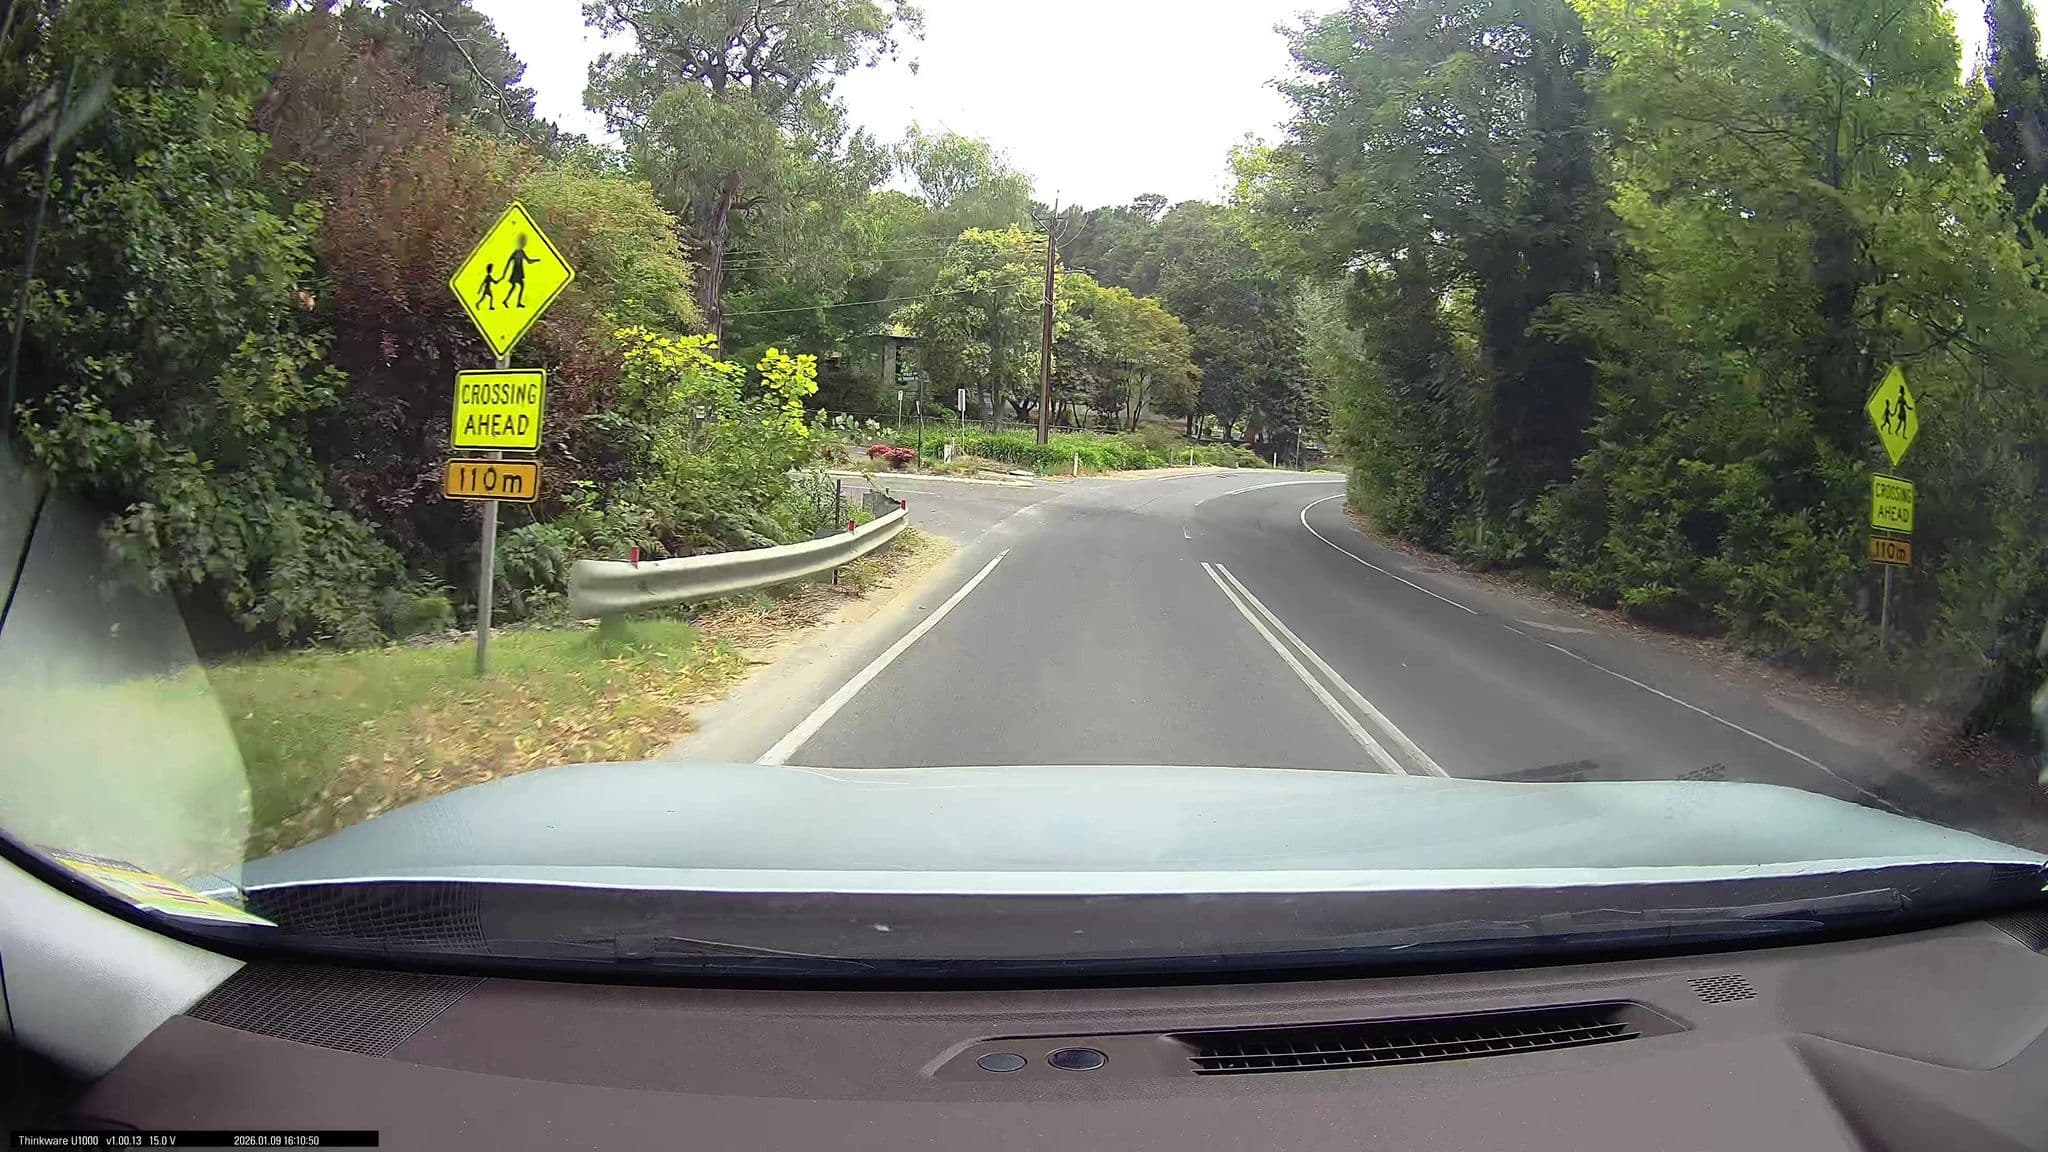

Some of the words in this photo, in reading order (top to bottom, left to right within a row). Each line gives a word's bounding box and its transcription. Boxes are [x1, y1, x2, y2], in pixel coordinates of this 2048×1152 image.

[461, 383, 537, 405] CROSSING
[463, 414, 530, 436] AHEAD
[460, 467, 523, 493] 110m
[1875, 483, 1912, 503] CROSSING
[1878, 505, 1909, 522] AHEAD
[1875, 541, 1905, 560] 110m
